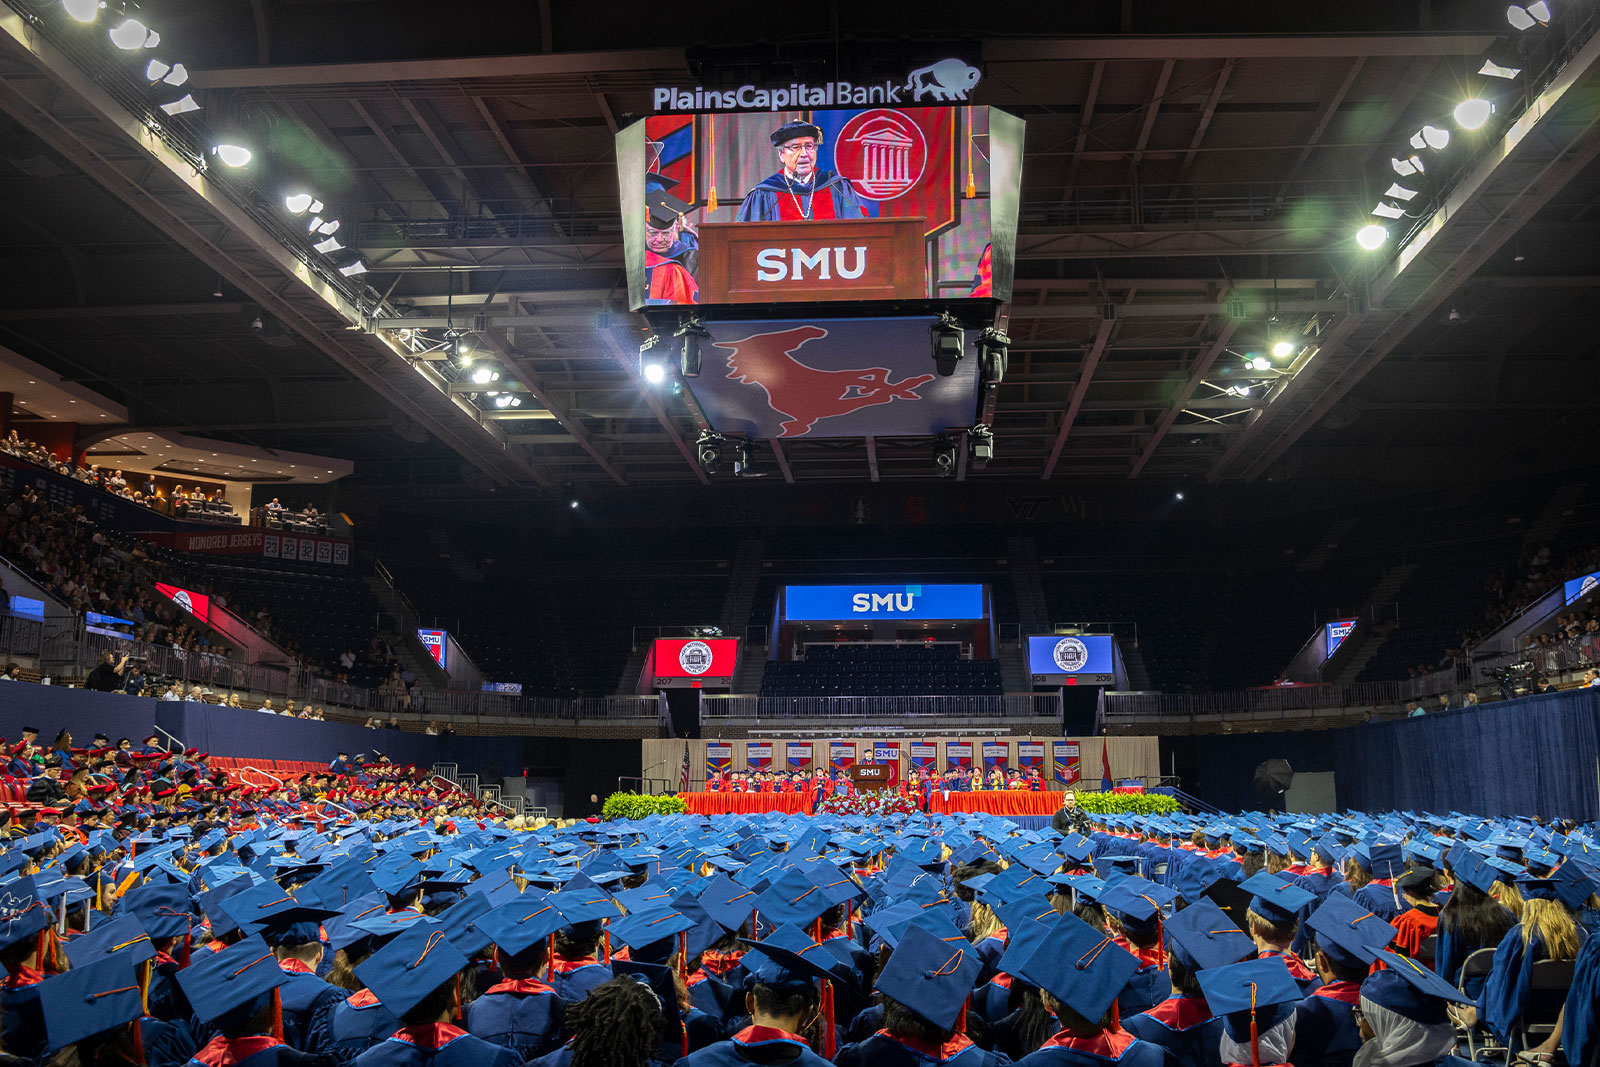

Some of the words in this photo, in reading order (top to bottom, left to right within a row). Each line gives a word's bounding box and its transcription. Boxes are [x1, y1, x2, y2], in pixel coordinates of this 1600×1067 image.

[756, 246, 867, 282] SMU
[188, 534, 228, 551] HONORED
[228, 532, 263, 549] JERSEYS
[265, 541, 277, 554] 23
[283, 543, 295, 556] 32
[318, 547, 330, 560] 53
[335, 549, 347, 561] 50
[852, 592, 916, 613] SMU
[423, 636, 440, 644] SMU
[656, 678, 673, 686] 207
[875, 749, 898, 758] SMU
[860, 768, 881, 776] SMU
